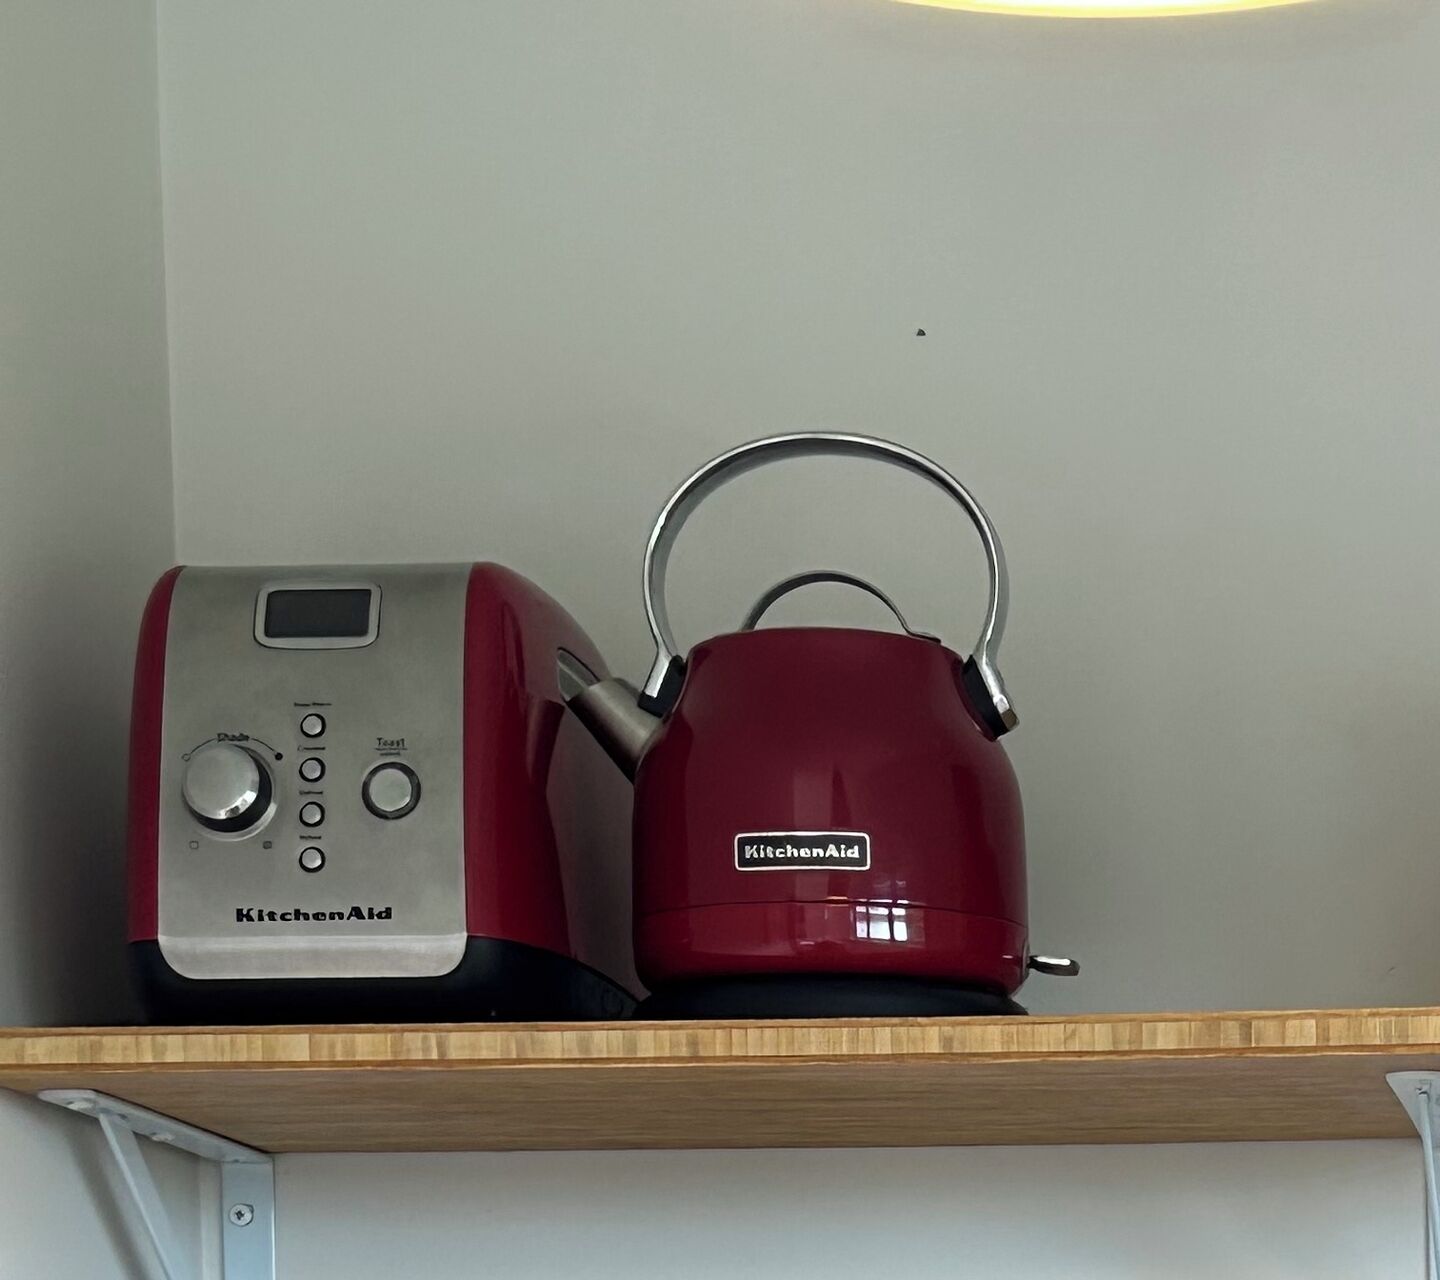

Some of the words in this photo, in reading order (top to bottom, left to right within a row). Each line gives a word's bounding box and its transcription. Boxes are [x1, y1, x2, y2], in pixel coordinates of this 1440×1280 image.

[376, 737, 406, 748] Toast
[744, 844, 860, 859] KitchenAid
[235, 906, 393, 922] KitchenAid
